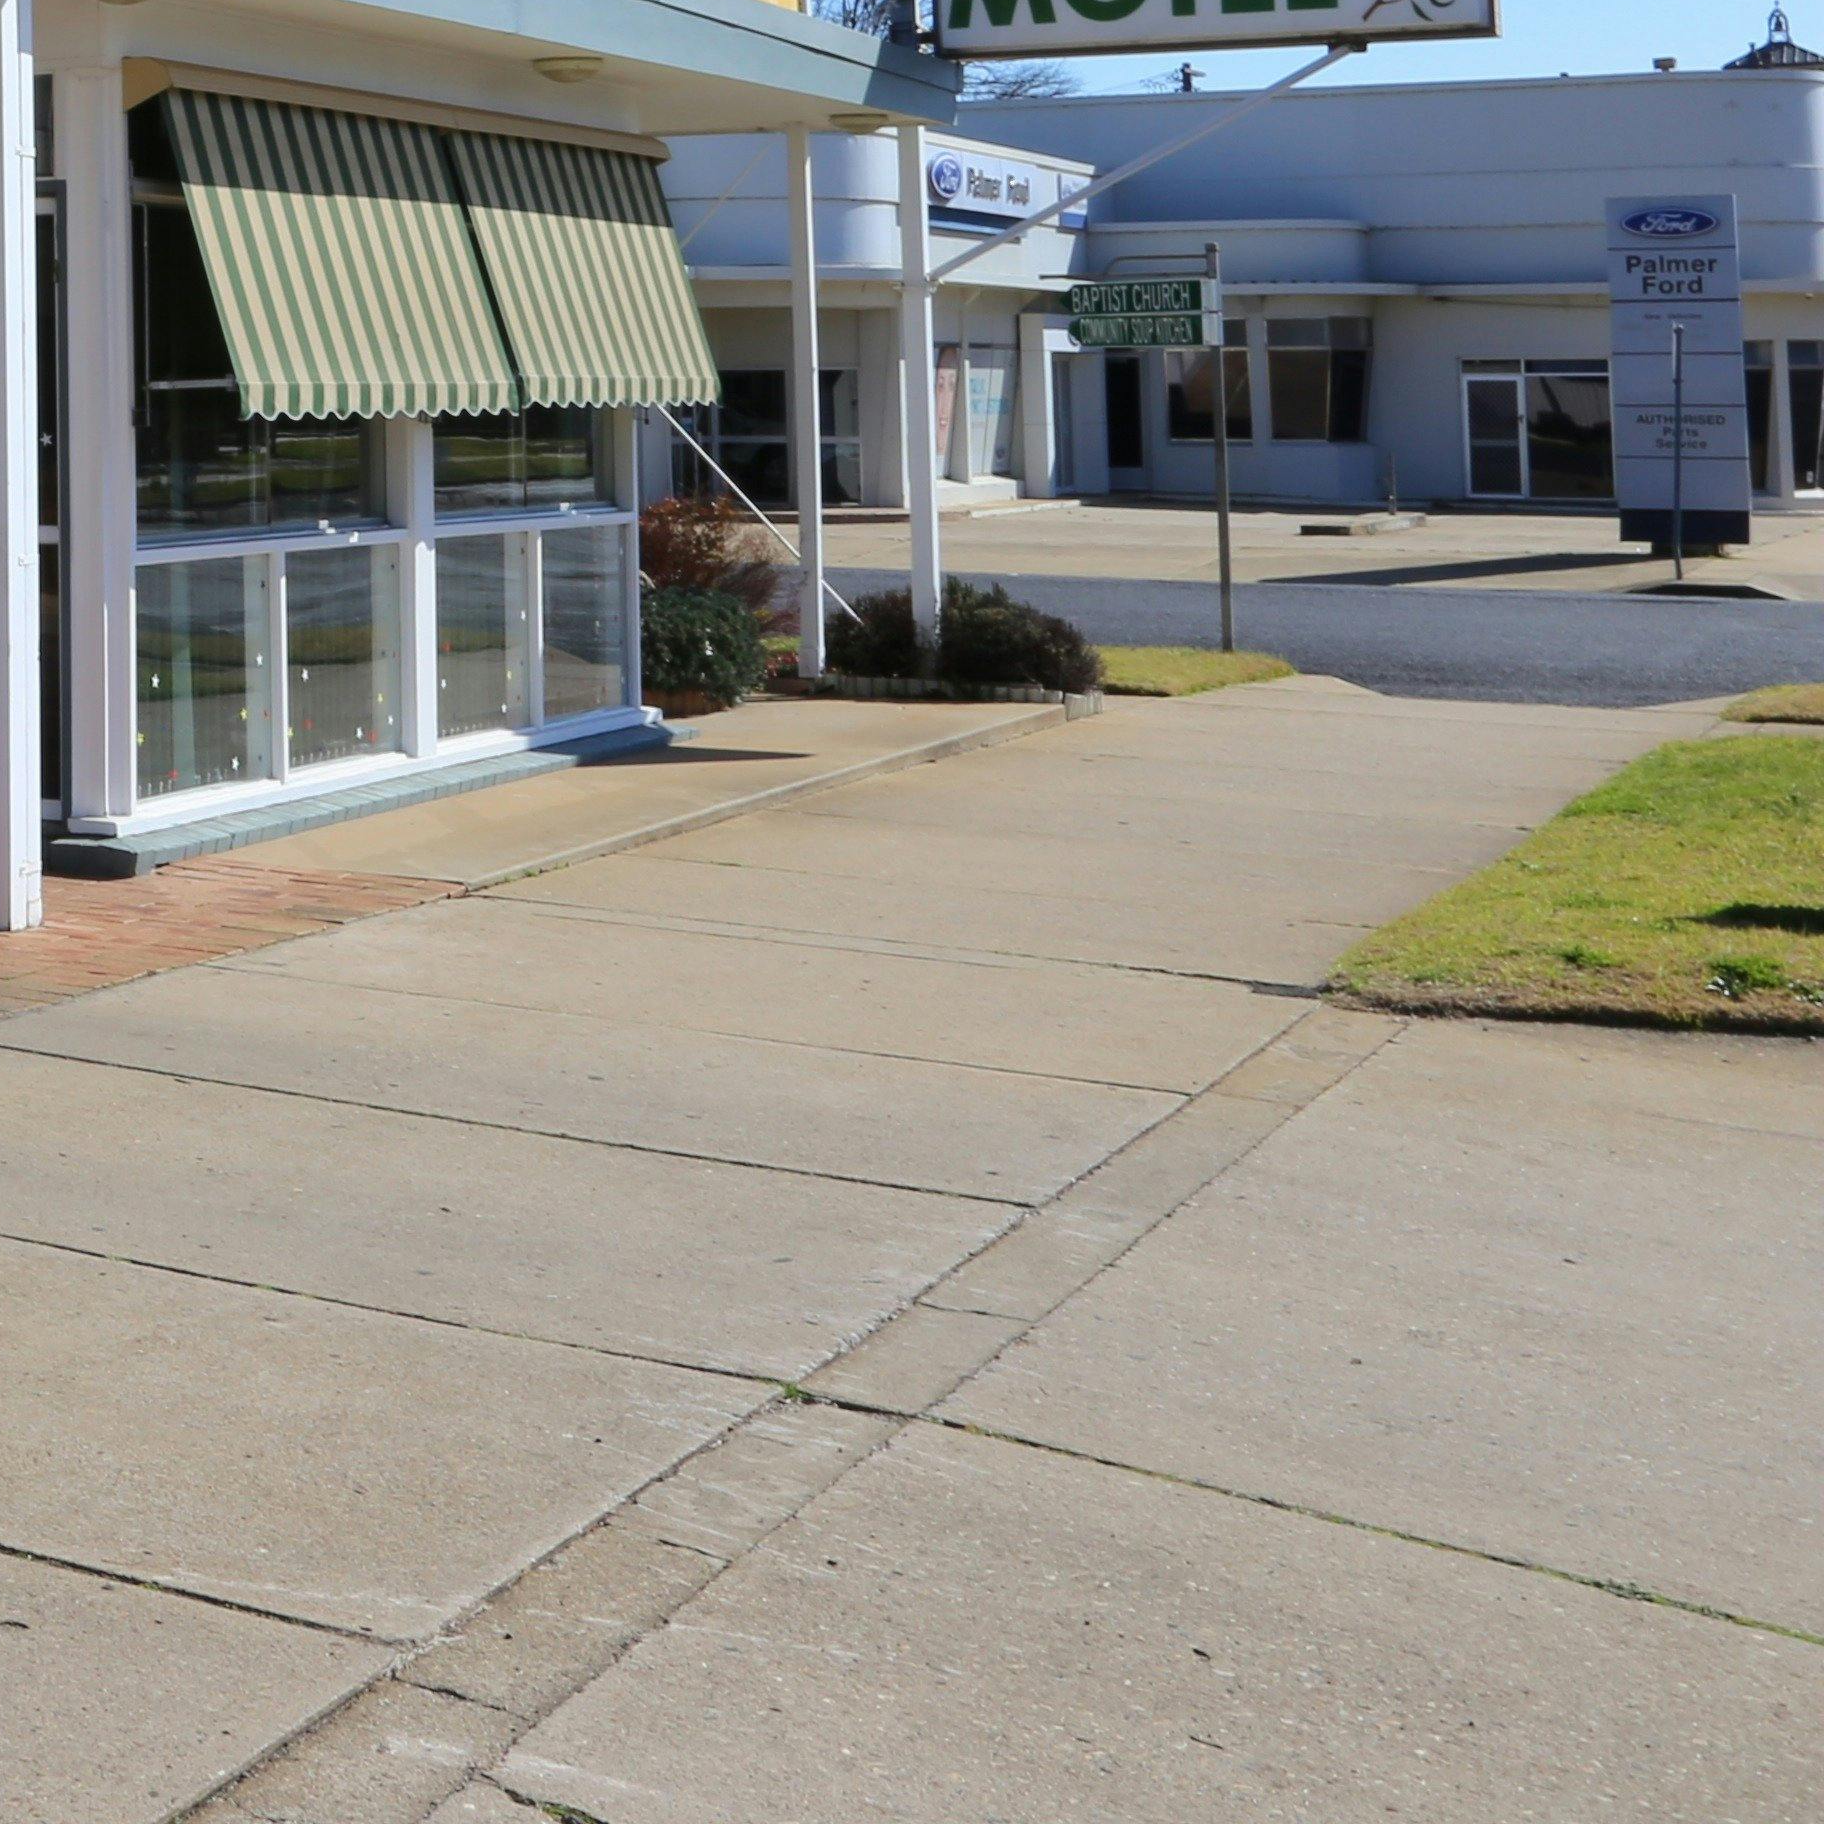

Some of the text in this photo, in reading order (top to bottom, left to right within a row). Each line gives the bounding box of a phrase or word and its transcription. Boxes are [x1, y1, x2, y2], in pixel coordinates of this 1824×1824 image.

[1640, 213, 1697, 233] Ford
[1625, 255, 1718, 274] Palmer
[1642, 275, 1703, 295] Ford
[1072, 283, 1191, 314] BAPTIST CHURCH
[1636, 414, 1727, 426] AUTHRISED
[1656, 438, 1708, 450] Sevice
